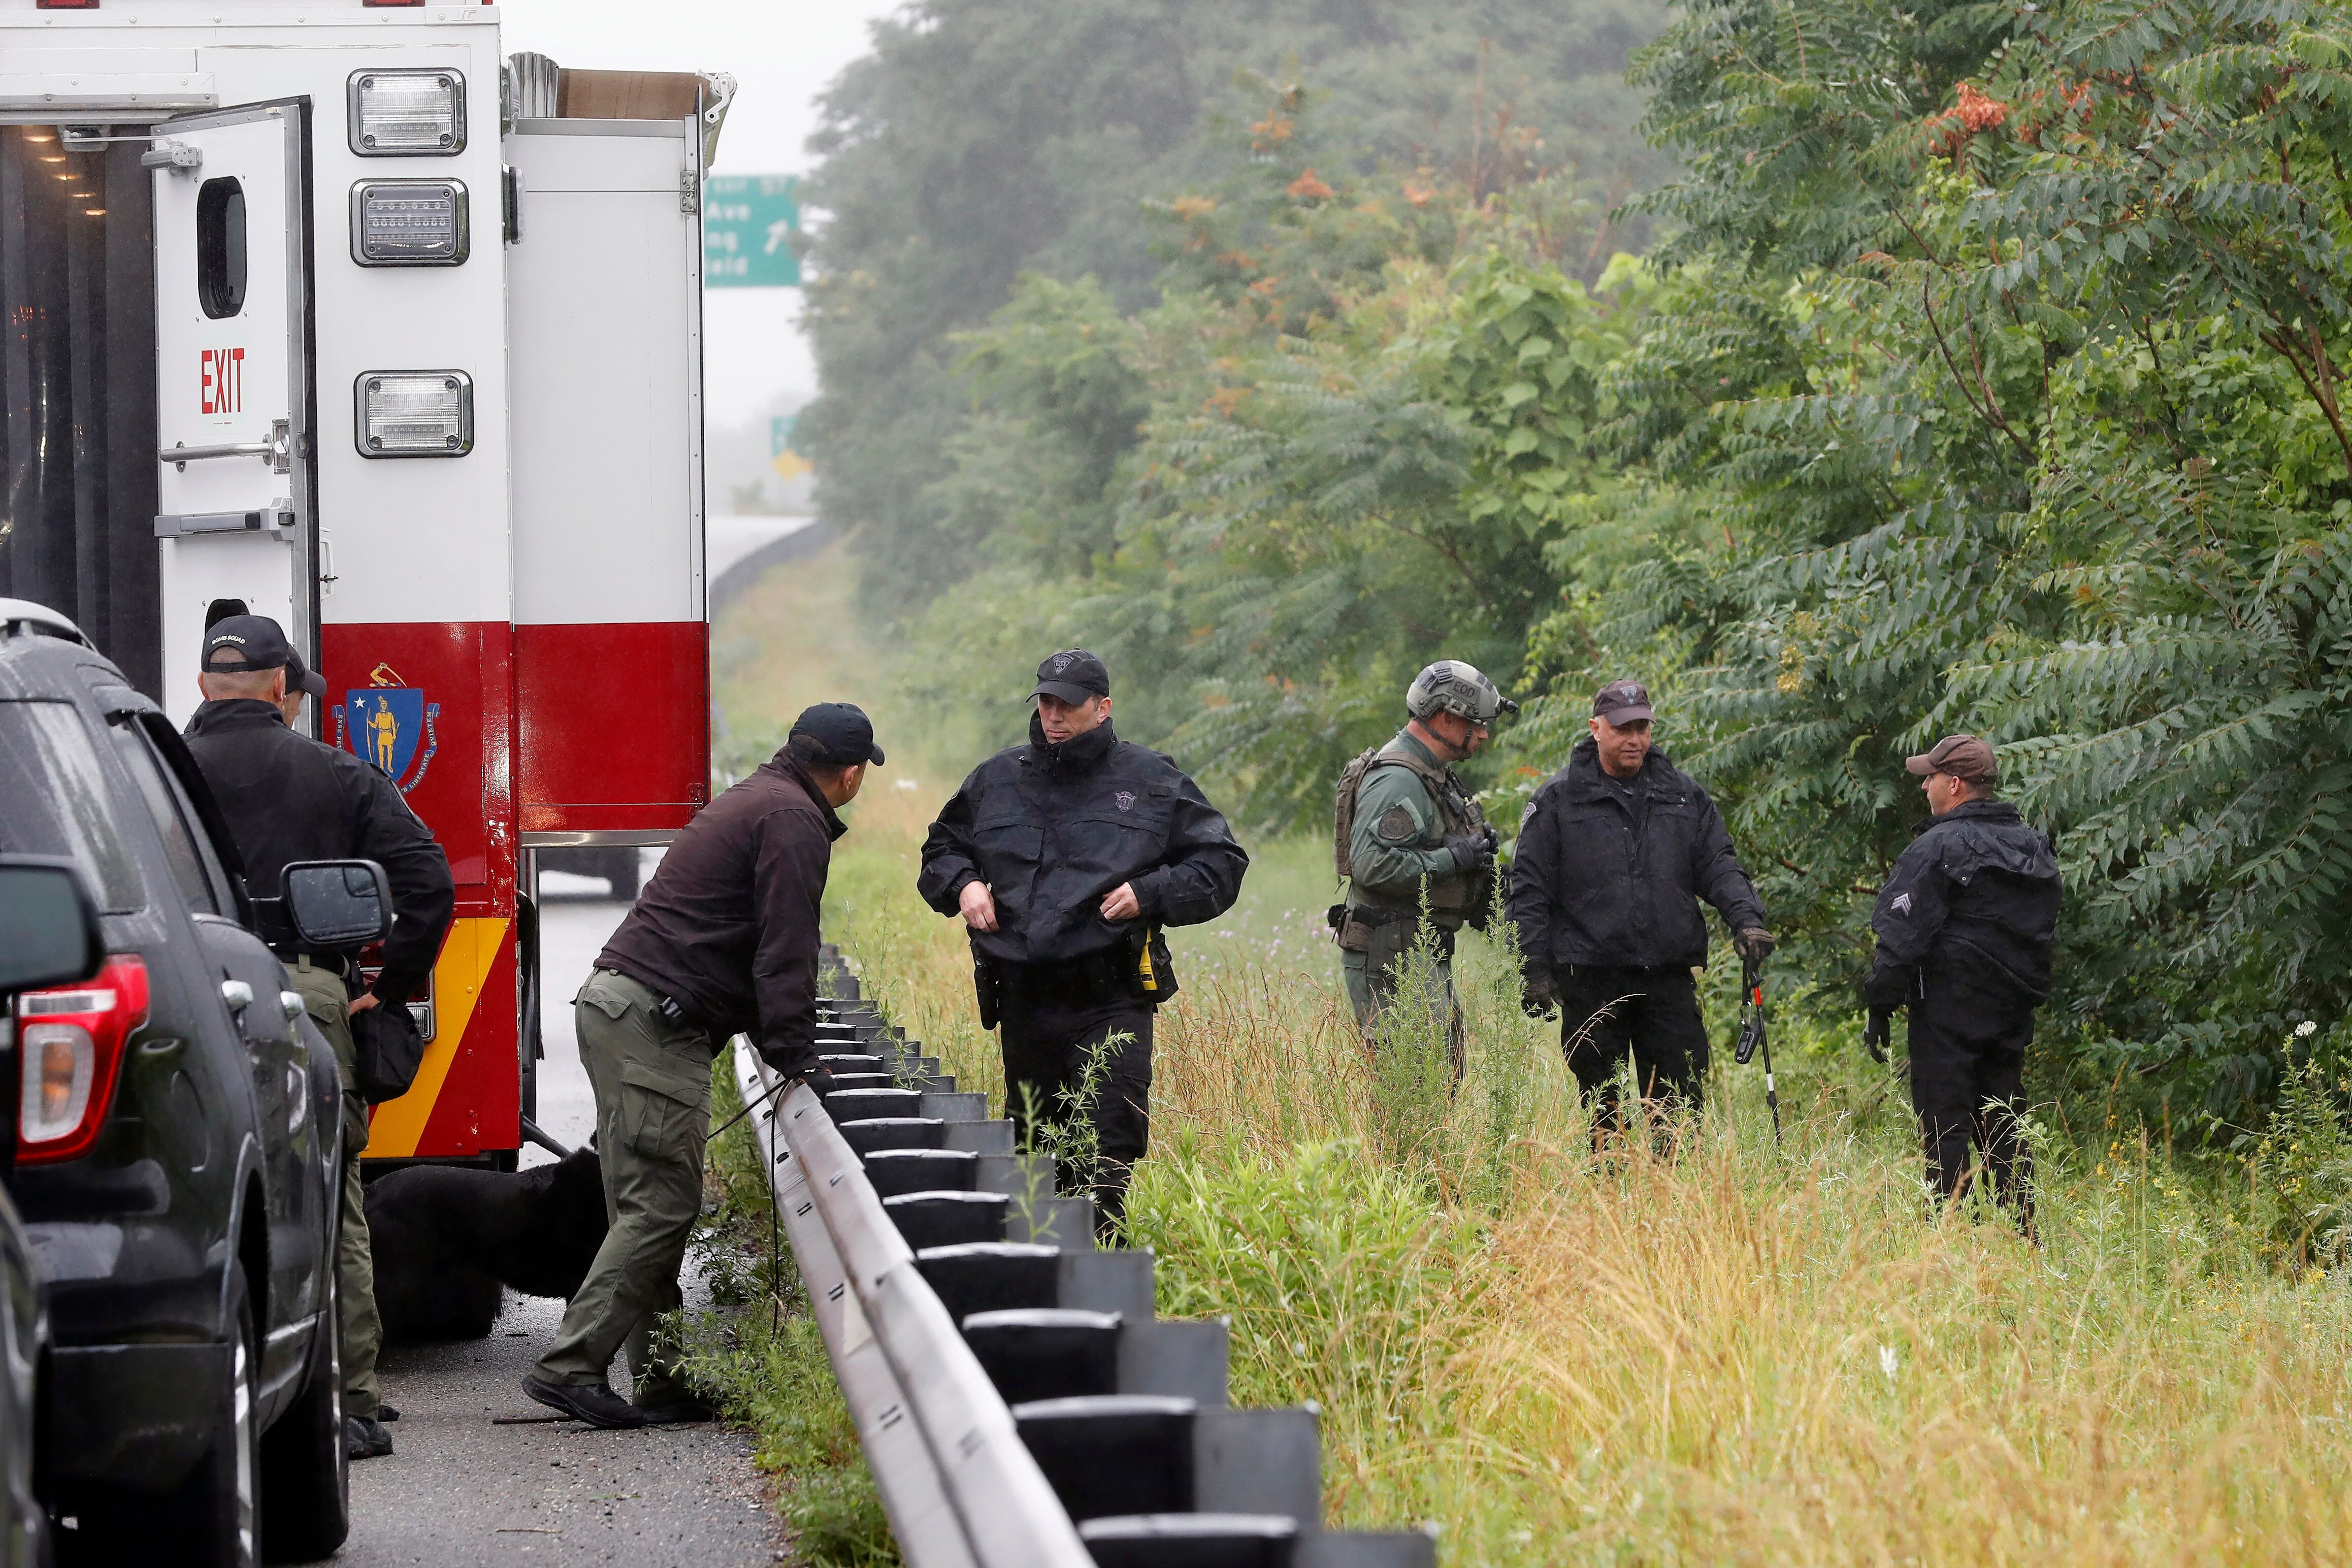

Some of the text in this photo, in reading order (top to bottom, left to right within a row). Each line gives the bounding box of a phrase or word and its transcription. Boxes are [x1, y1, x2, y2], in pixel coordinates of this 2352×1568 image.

[705, 202, 749, 221] Ave
[202, 348, 244, 414] EXIT
[212, 635, 245, 645] BOMB SQUAD
[1454, 681, 1475, 697] EOD
[409, 753, 430, 789] LIBERTATE
